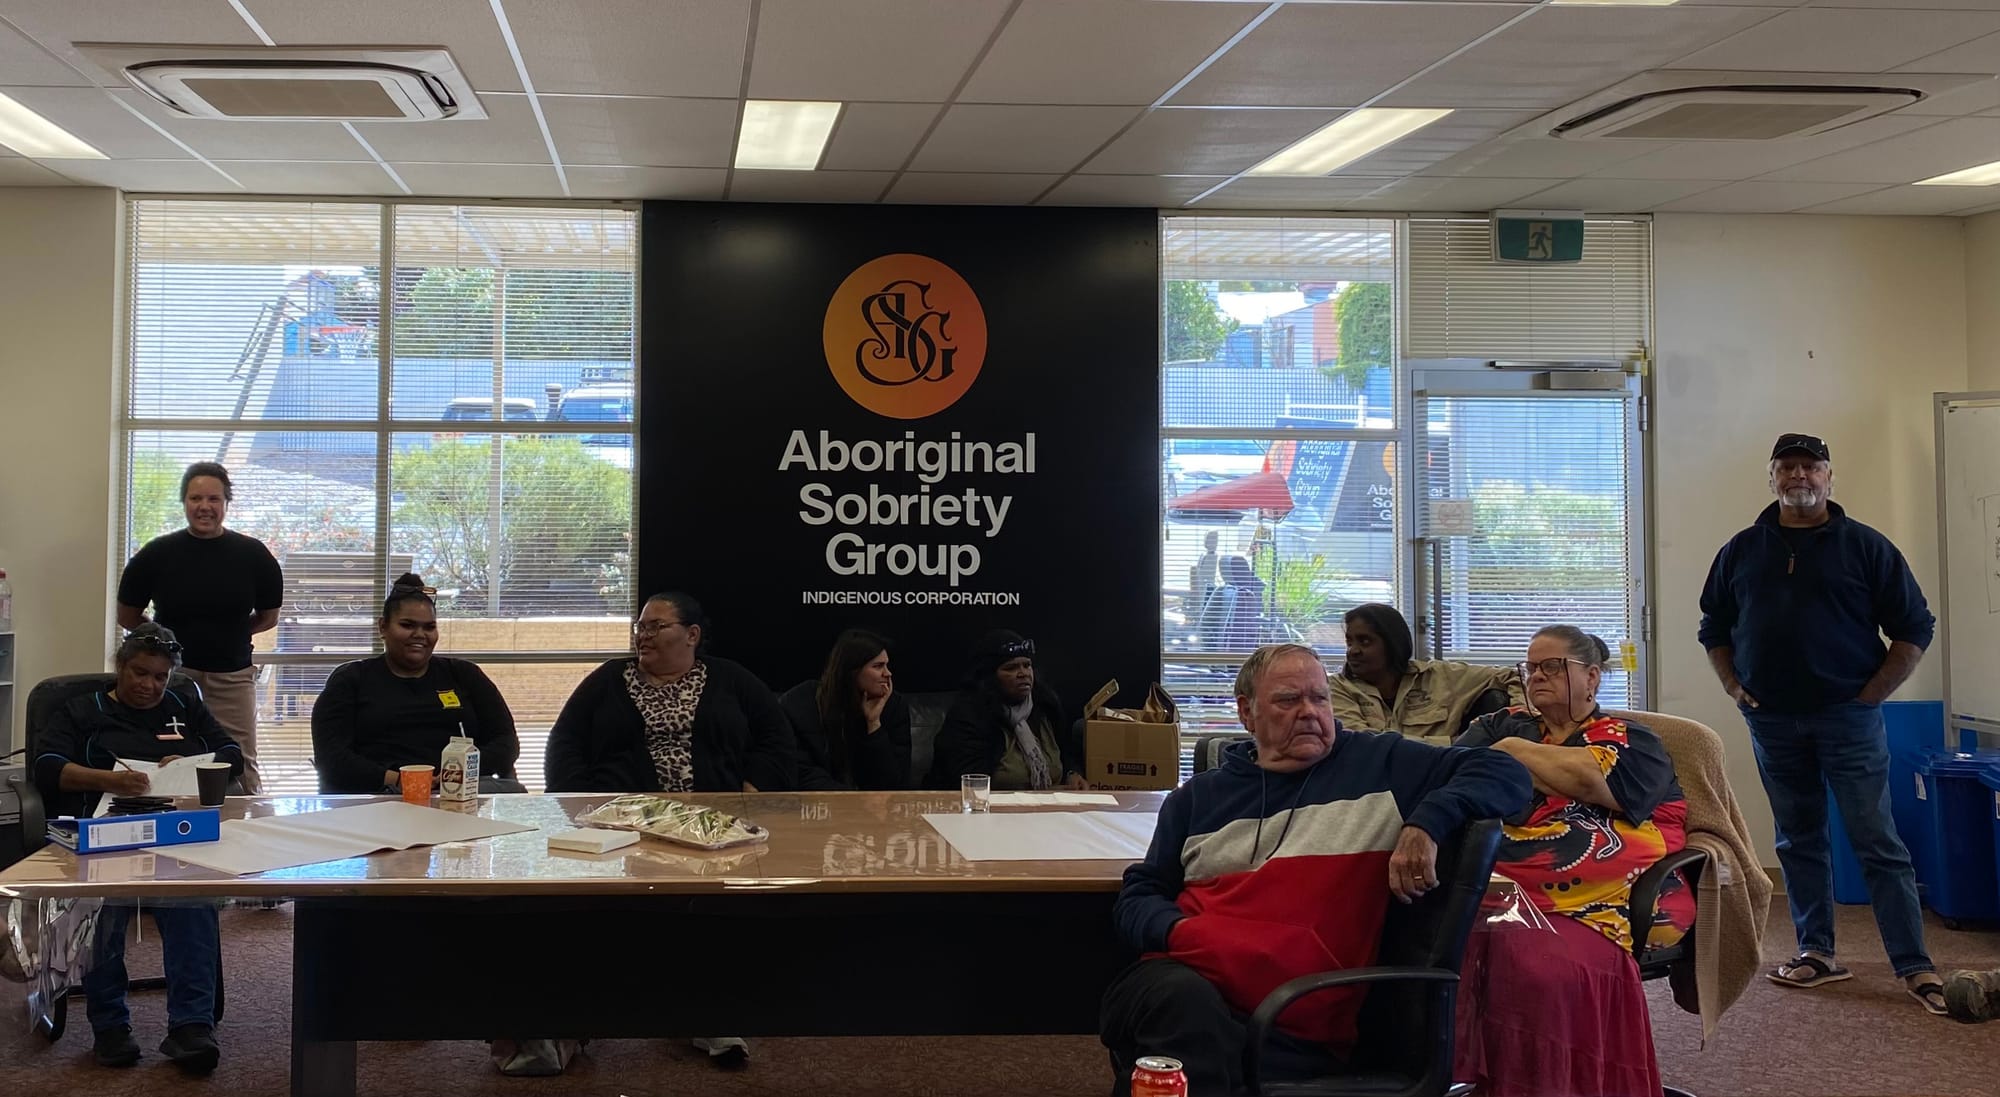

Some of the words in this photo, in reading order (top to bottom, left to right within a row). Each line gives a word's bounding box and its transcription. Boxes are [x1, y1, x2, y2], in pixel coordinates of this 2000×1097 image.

[778, 429, 1036, 483] Aboriginal
[799, 482, 1012, 537] Sobriety
[825, 532, 981, 586] Group
[802, 591, 902, 605] INDIGENOUS
[904, 591, 1020, 606] CORPORATION
